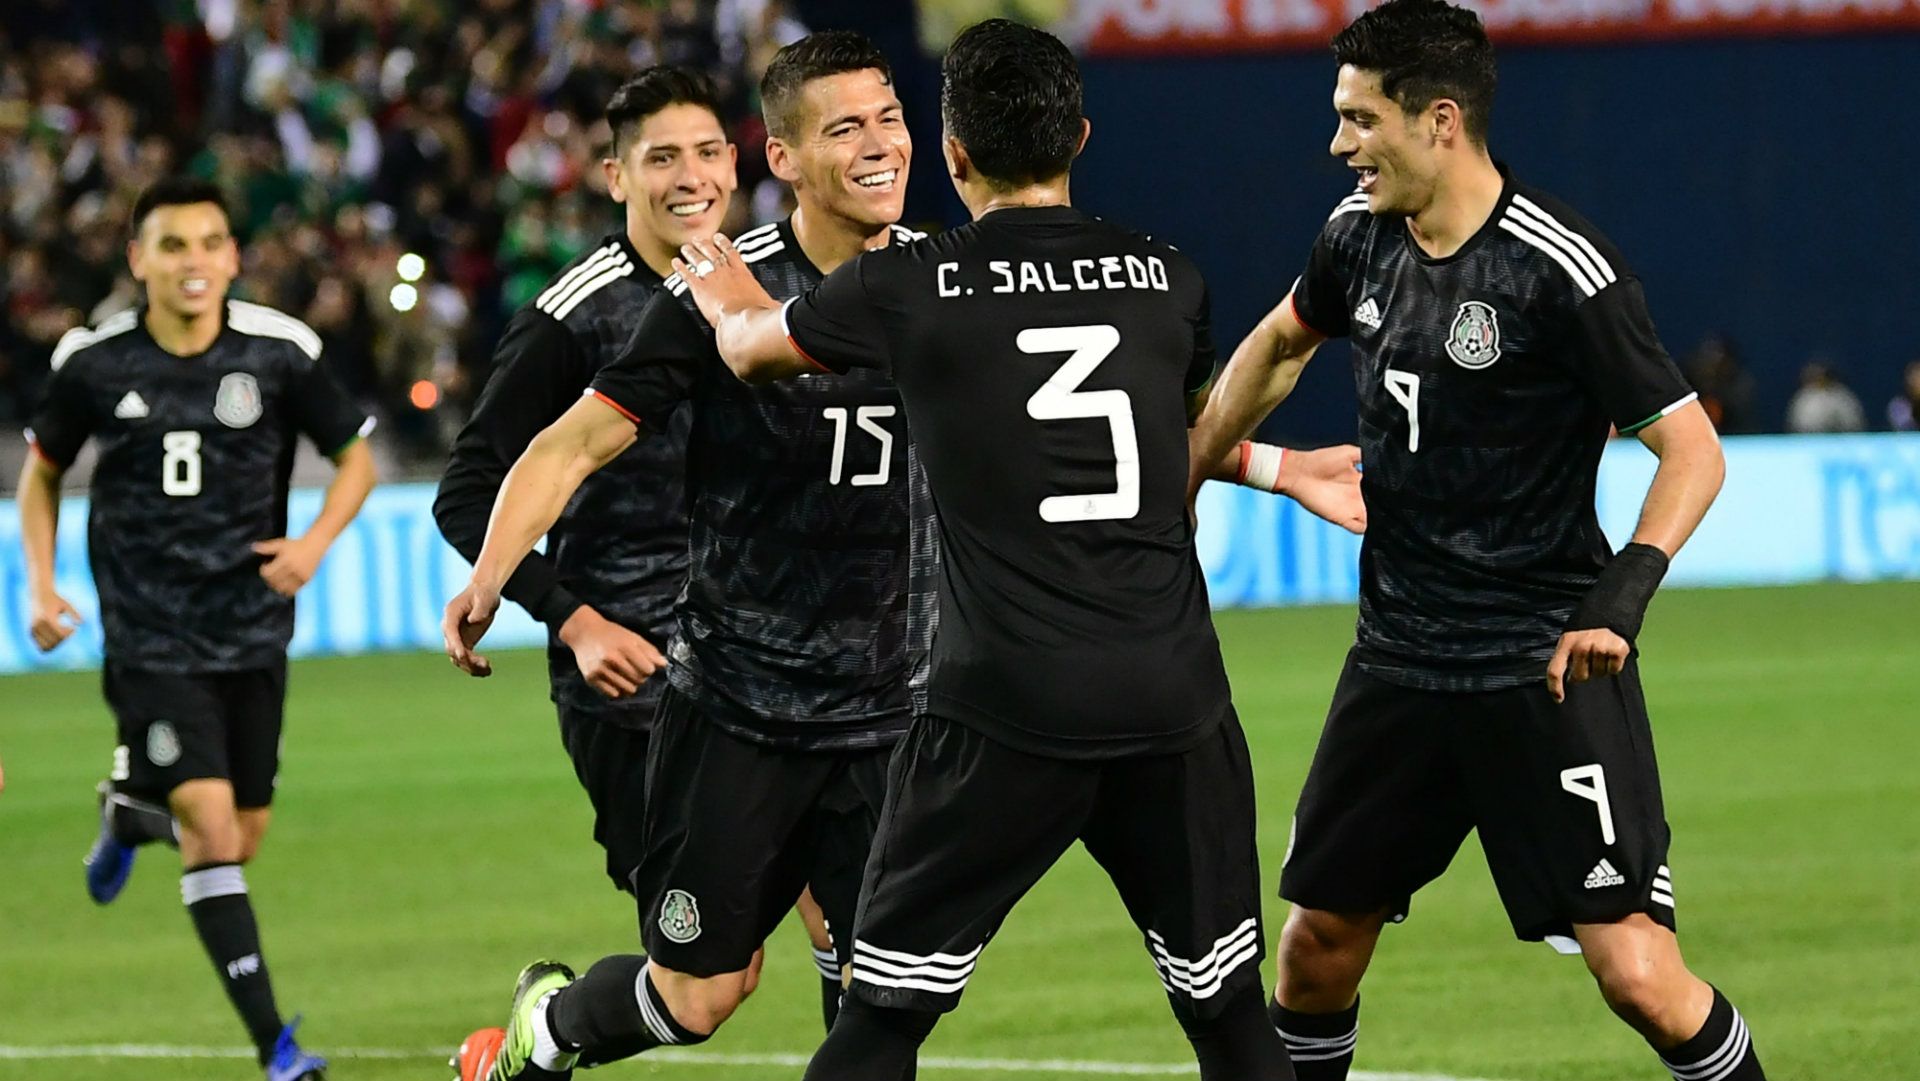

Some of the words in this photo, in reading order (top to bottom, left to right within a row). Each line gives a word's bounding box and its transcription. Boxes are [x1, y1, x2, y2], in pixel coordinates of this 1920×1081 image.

[937, 261, 975, 298] C.
[989, 255, 1170, 294] SALCEDO
[823, 405, 897, 487] 15
[1016, 324, 1141, 523] 3
[1384, 369, 1420, 453] 9
[163, 430, 202, 497] 8
[1560, 763, 1616, 846] 9
[1584, 874, 1626, 889] adidas
